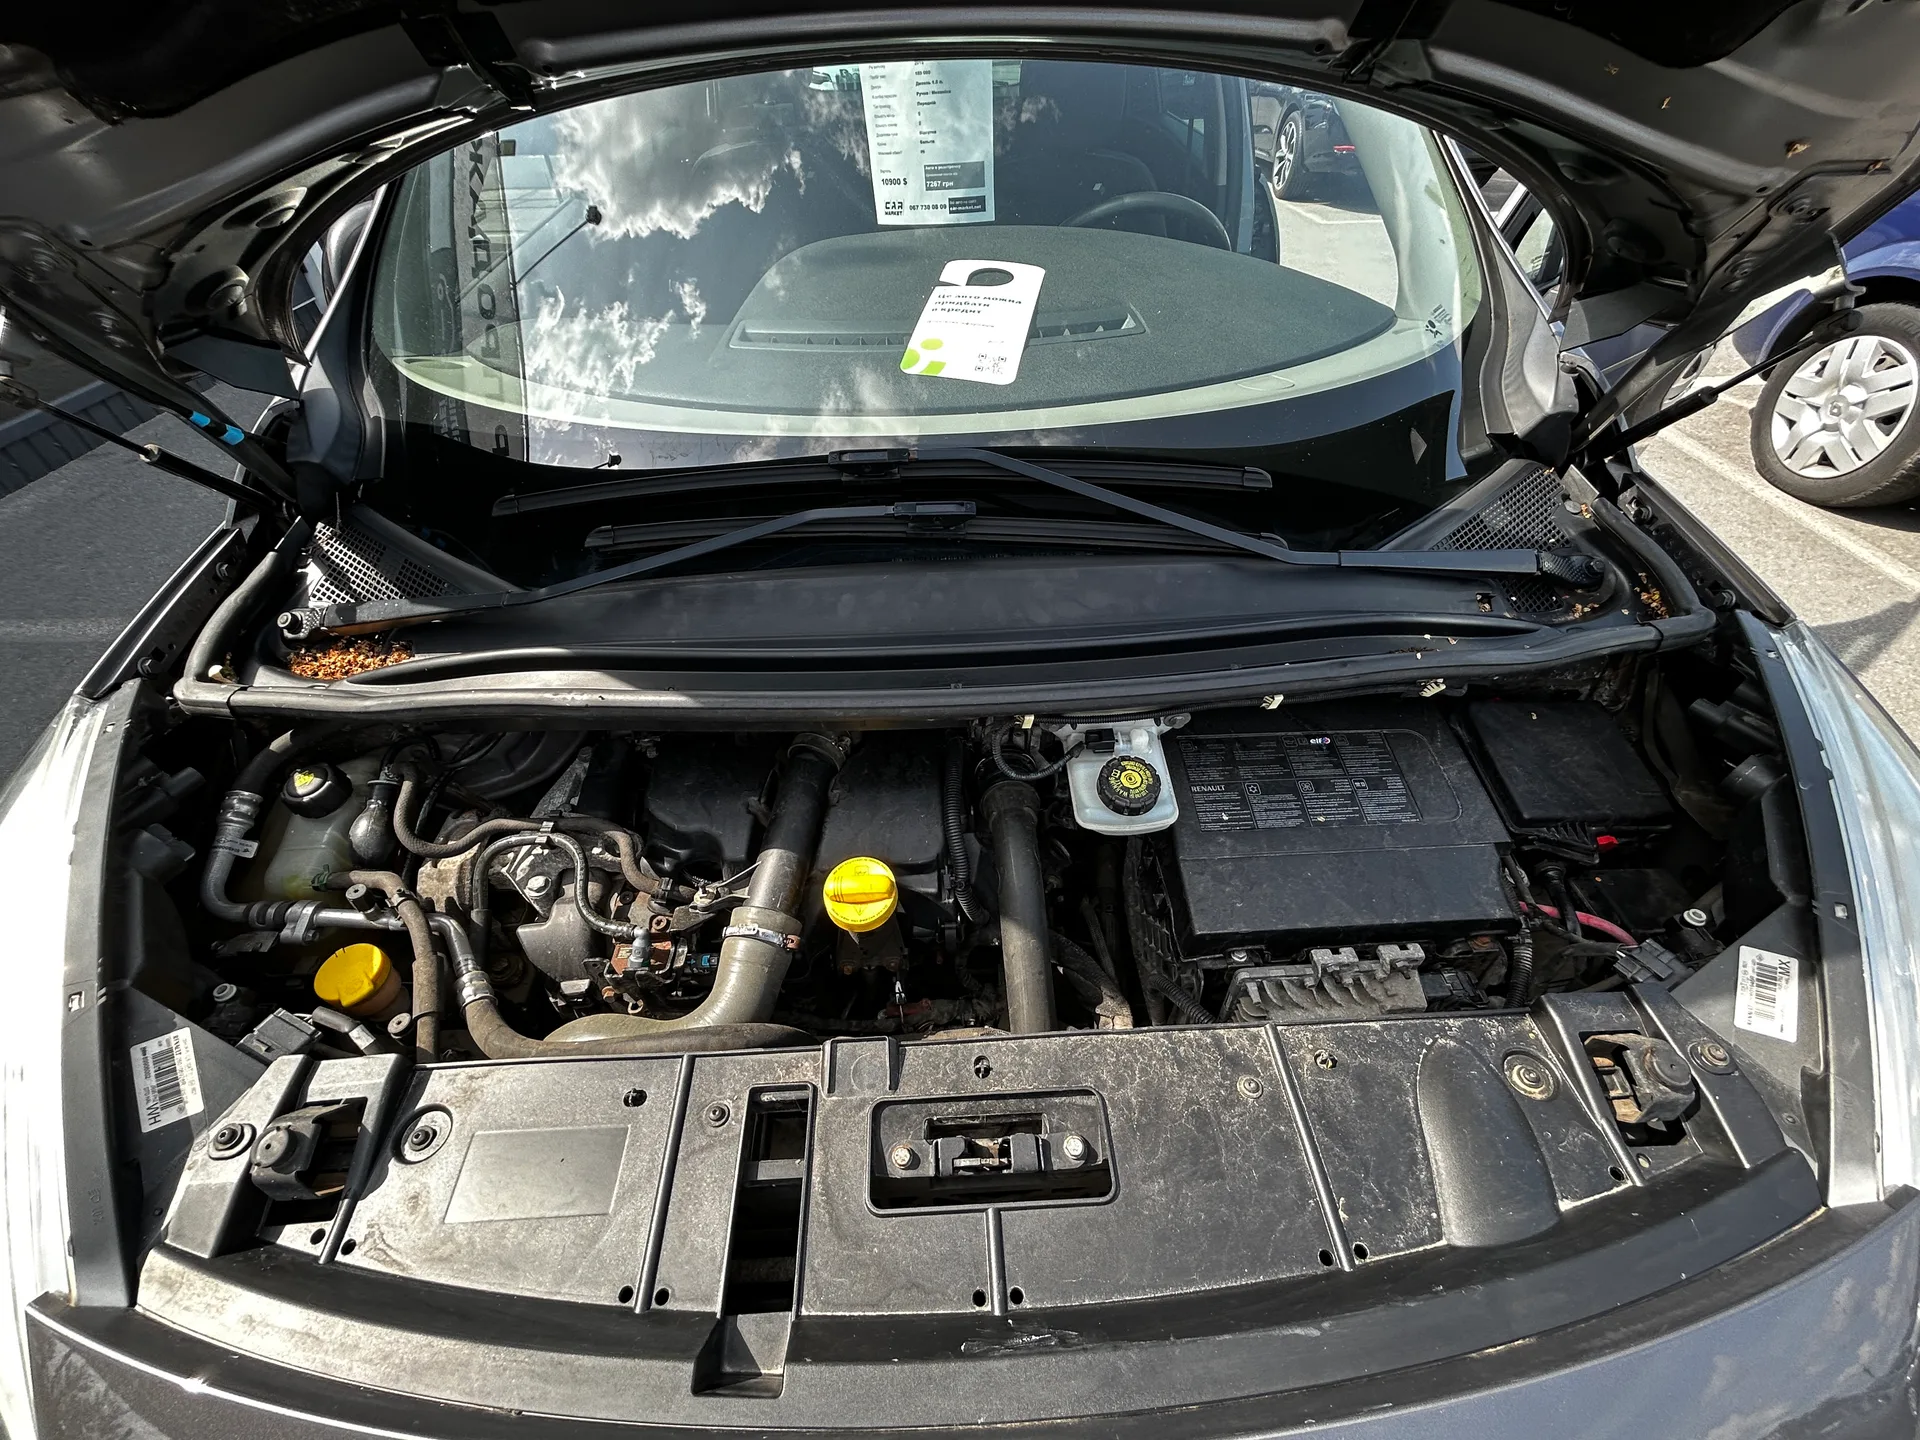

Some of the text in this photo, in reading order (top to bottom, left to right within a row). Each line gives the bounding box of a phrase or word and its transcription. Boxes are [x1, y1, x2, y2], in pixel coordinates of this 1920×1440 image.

[885, 202, 903, 210] CAR
[1778, 959, 1790, 977] MX
[146, 1102, 161, 1126] WH
